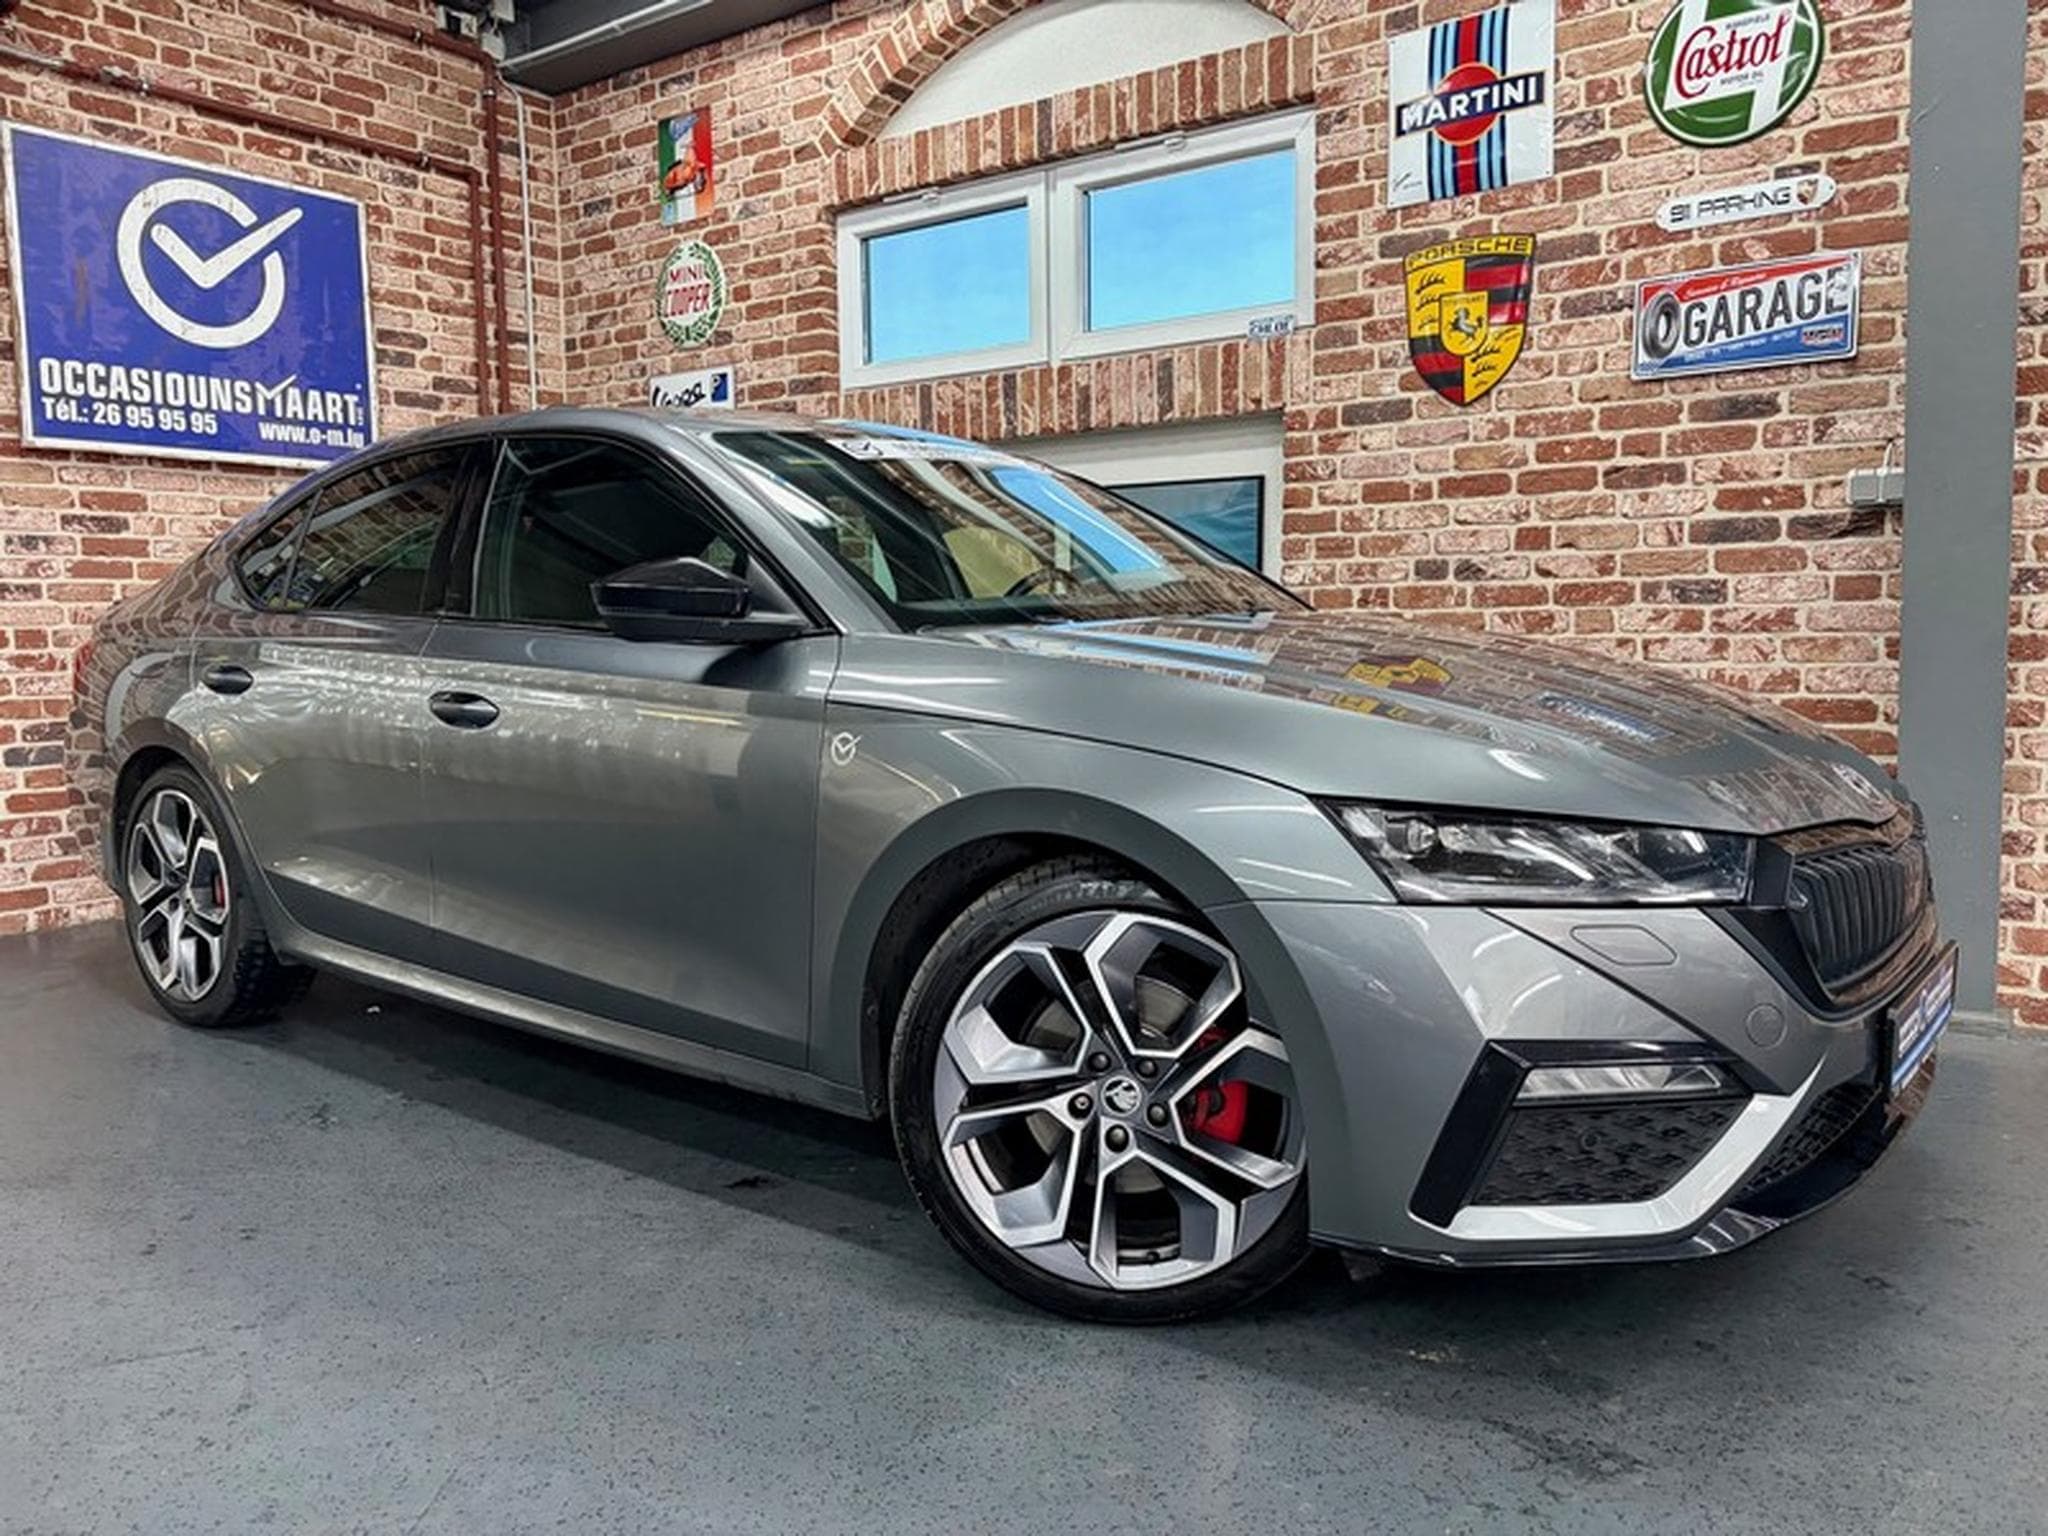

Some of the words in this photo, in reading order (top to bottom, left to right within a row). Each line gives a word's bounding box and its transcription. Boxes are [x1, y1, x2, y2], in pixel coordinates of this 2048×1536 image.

[1675, 9, 1791, 99] Castrol
[1401, 76, 1537, 132] MARTINI
[1697, 186, 1791, 217] PARKING
[1409, 237, 1529, 267] PORSCHE
[1682, 266, 1849, 348] GARAGE
[92, 402, 121, 426] 26
[125, 404, 154, 429] 95
[158, 407, 187, 432] 95
[190, 411, 218, 436] 95
